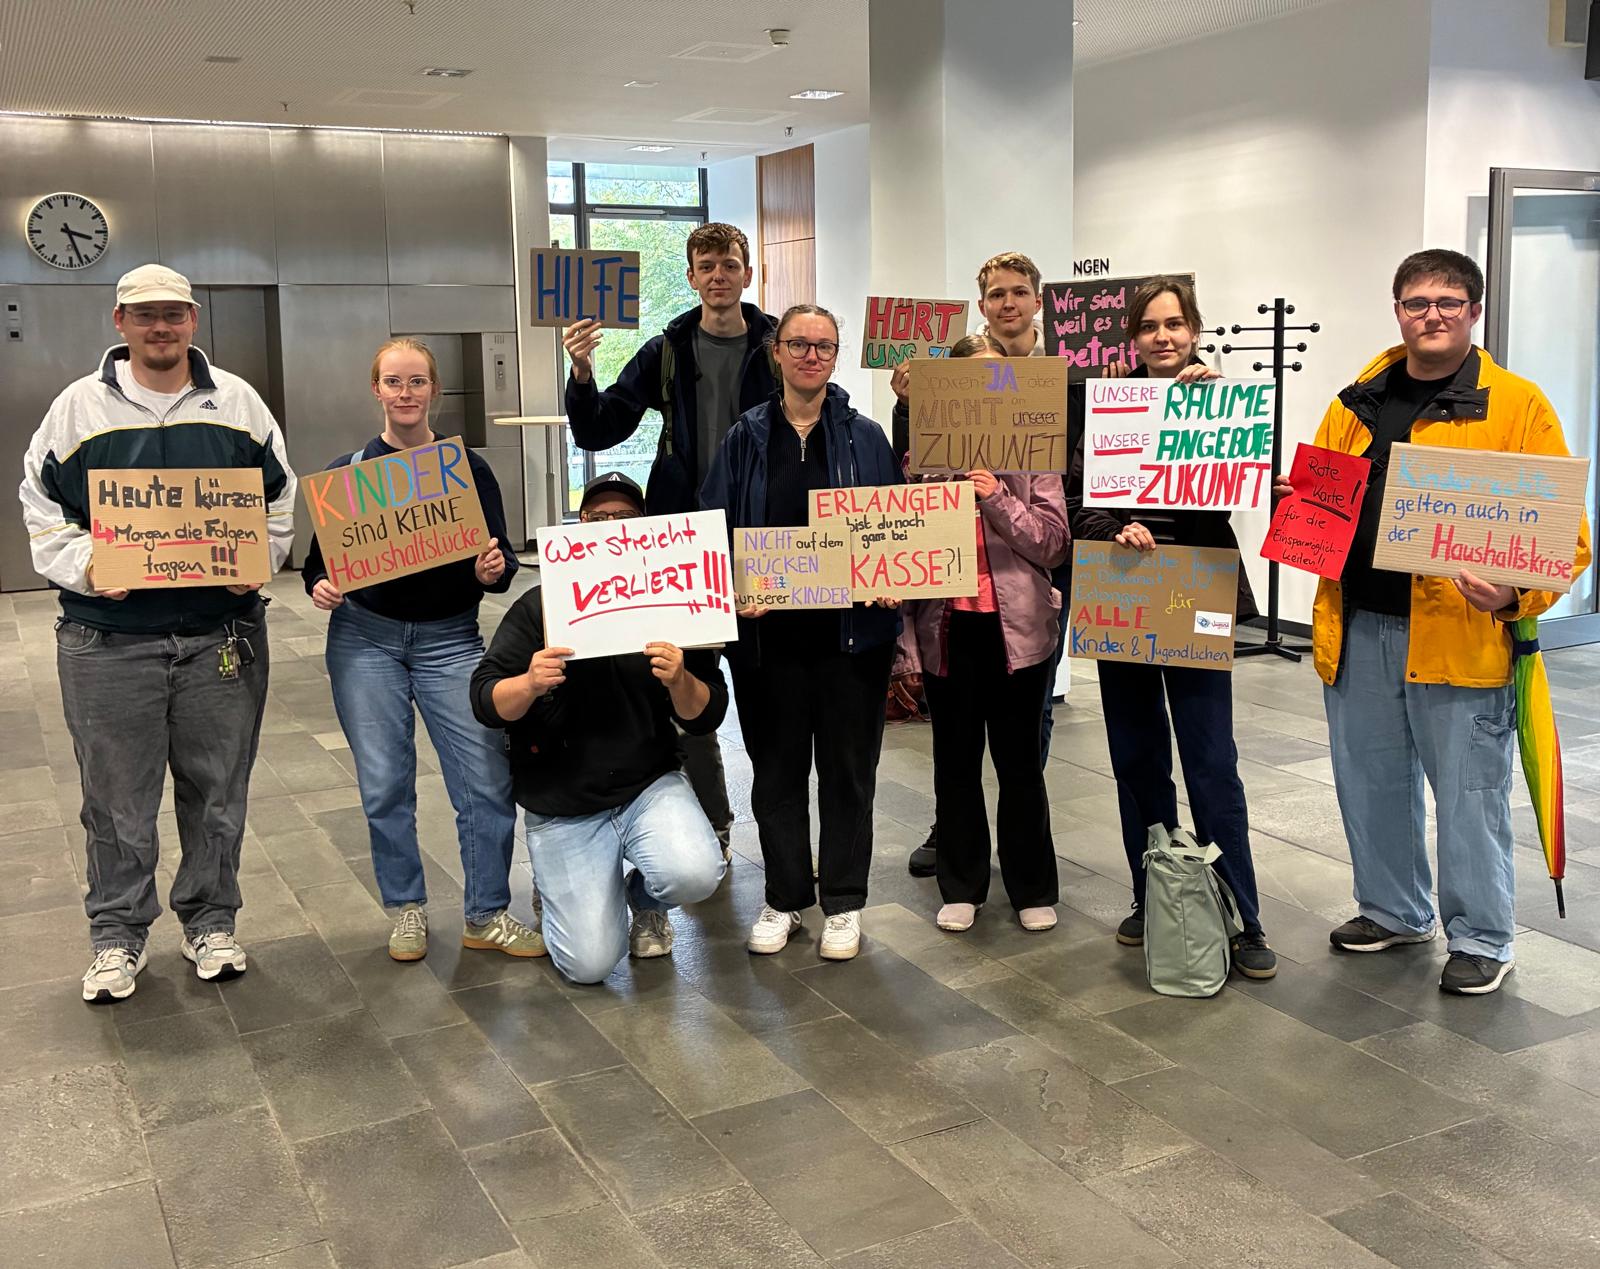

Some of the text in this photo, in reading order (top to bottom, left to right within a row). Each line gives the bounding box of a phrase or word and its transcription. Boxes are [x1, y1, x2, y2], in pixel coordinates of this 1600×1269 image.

[537, 254, 639, 322] HILFE
[1051, 287, 1125, 314] Wir sind
[869, 297, 964, 343] HÖRT
[1054, 312, 1086, 337] weil
[1094, 316, 1112, 332] es
[984, 361, 1019, 393] JA
[1093, 384, 1159, 404] UNSERE
[915, 397, 1004, 429] NICHT
[1012, 411, 1060, 426] unserer
[918, 433, 1065, 472] ZUKUNFT
[1092, 423, 1275, 461] UNSERE ANGEBOTE
[1308, 456, 1341, 481] Rote
[98, 475, 183, 509] Heute
[310, 443, 469, 527] KINDER
[816, 483, 961, 518] ERLANGEN
[1090, 462, 1271, 508] UNSERE ZUKUNFT
[342, 496, 464, 547] sind KEINE
[877, 514, 893, 530] du
[895, 512, 925, 528] noch
[1306, 512, 1326, 529] die
[1392, 492, 1539, 523] gelten auch in
[115, 518, 258, 551] Morgen die Folgen
[545, 535, 597, 563] Wer
[745, 529, 844, 552] NICHT auf dem
[892, 529, 908, 541] bei
[329, 523, 481, 587] Haushaltslücke
[745, 553, 819, 577] RÜCKEN
[1387, 522, 1574, 580] der Haushaltskrise
[851, 547, 963, 589] KASSE?!
[738, 585, 851, 605] unserer KINDER
[1165, 589, 1196, 615] für
[1075, 605, 1151, 629] ALLE
[1072, 626, 1230, 664] Kinder & Jugendlichen
